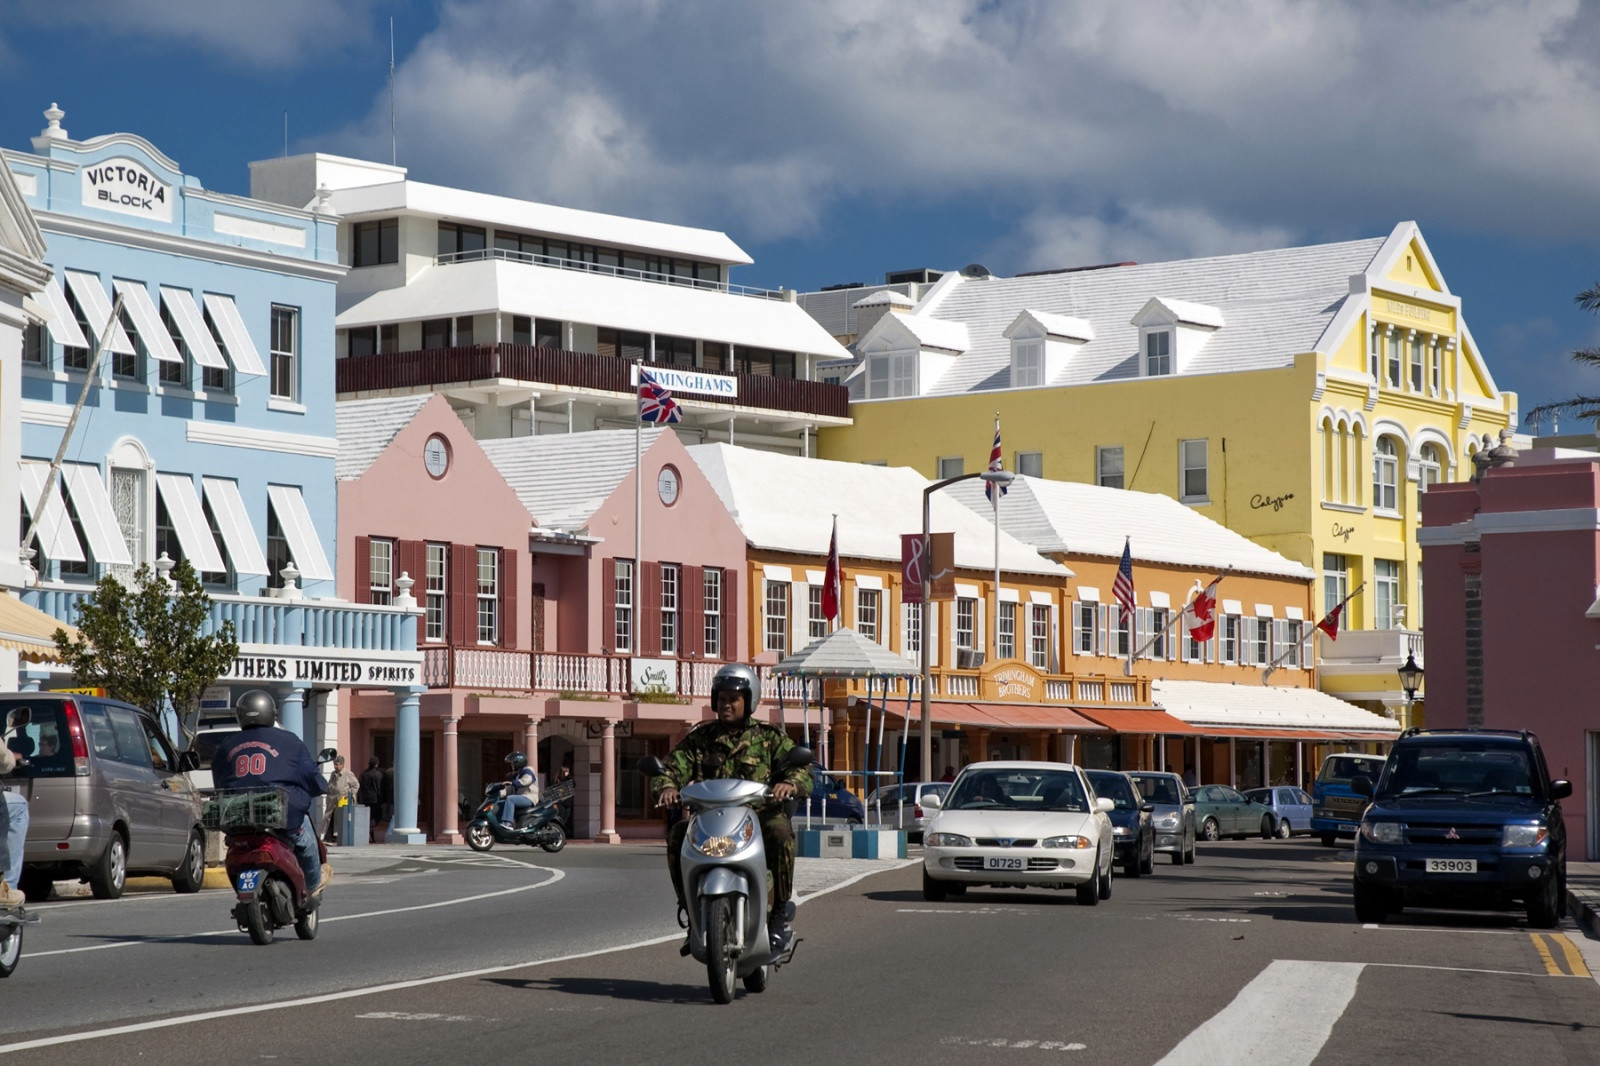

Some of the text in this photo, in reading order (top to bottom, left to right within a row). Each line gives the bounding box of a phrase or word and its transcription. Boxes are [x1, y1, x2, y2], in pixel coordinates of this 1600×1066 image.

[87, 166, 165, 204] VICTORIA
[98, 189, 153, 210] BLOCK
[1250, 493, 1294, 512] Calypso
[1331, 522, 1355, 543] Calypso
[295, 659, 362, 682] LIMITED
[368, 665, 415, 681] SPIRITS
[993, 669, 1035, 688] TRIMINGHAM
[998, 682, 1031, 699] BROTHERS
[235, 752, 266, 777] 80
[990, 858, 1022, 868] 01729
[1431, 861, 1472, 871] 33903
[240, 871, 258, 879] 697
